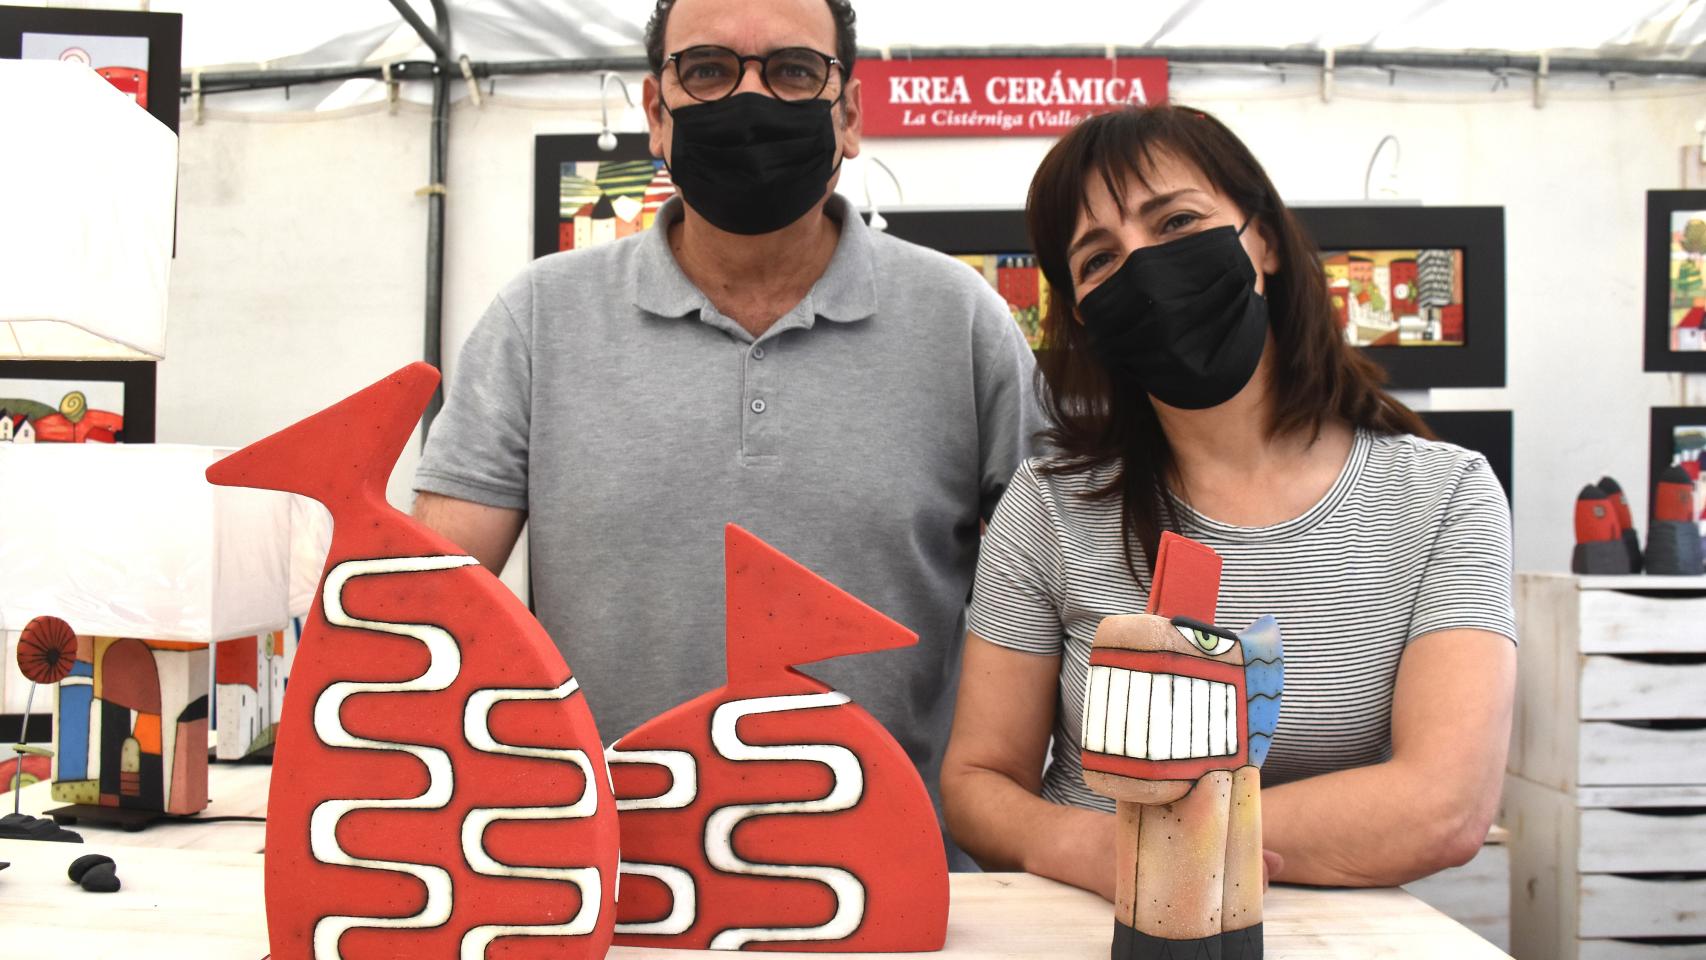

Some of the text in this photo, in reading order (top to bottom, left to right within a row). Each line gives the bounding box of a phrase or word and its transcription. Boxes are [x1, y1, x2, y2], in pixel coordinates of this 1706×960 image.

[888, 69, 1147, 106] KREA CERÁMICA
[902, 109, 926, 126] La
[931, 109, 1023, 130] Cistérniga
